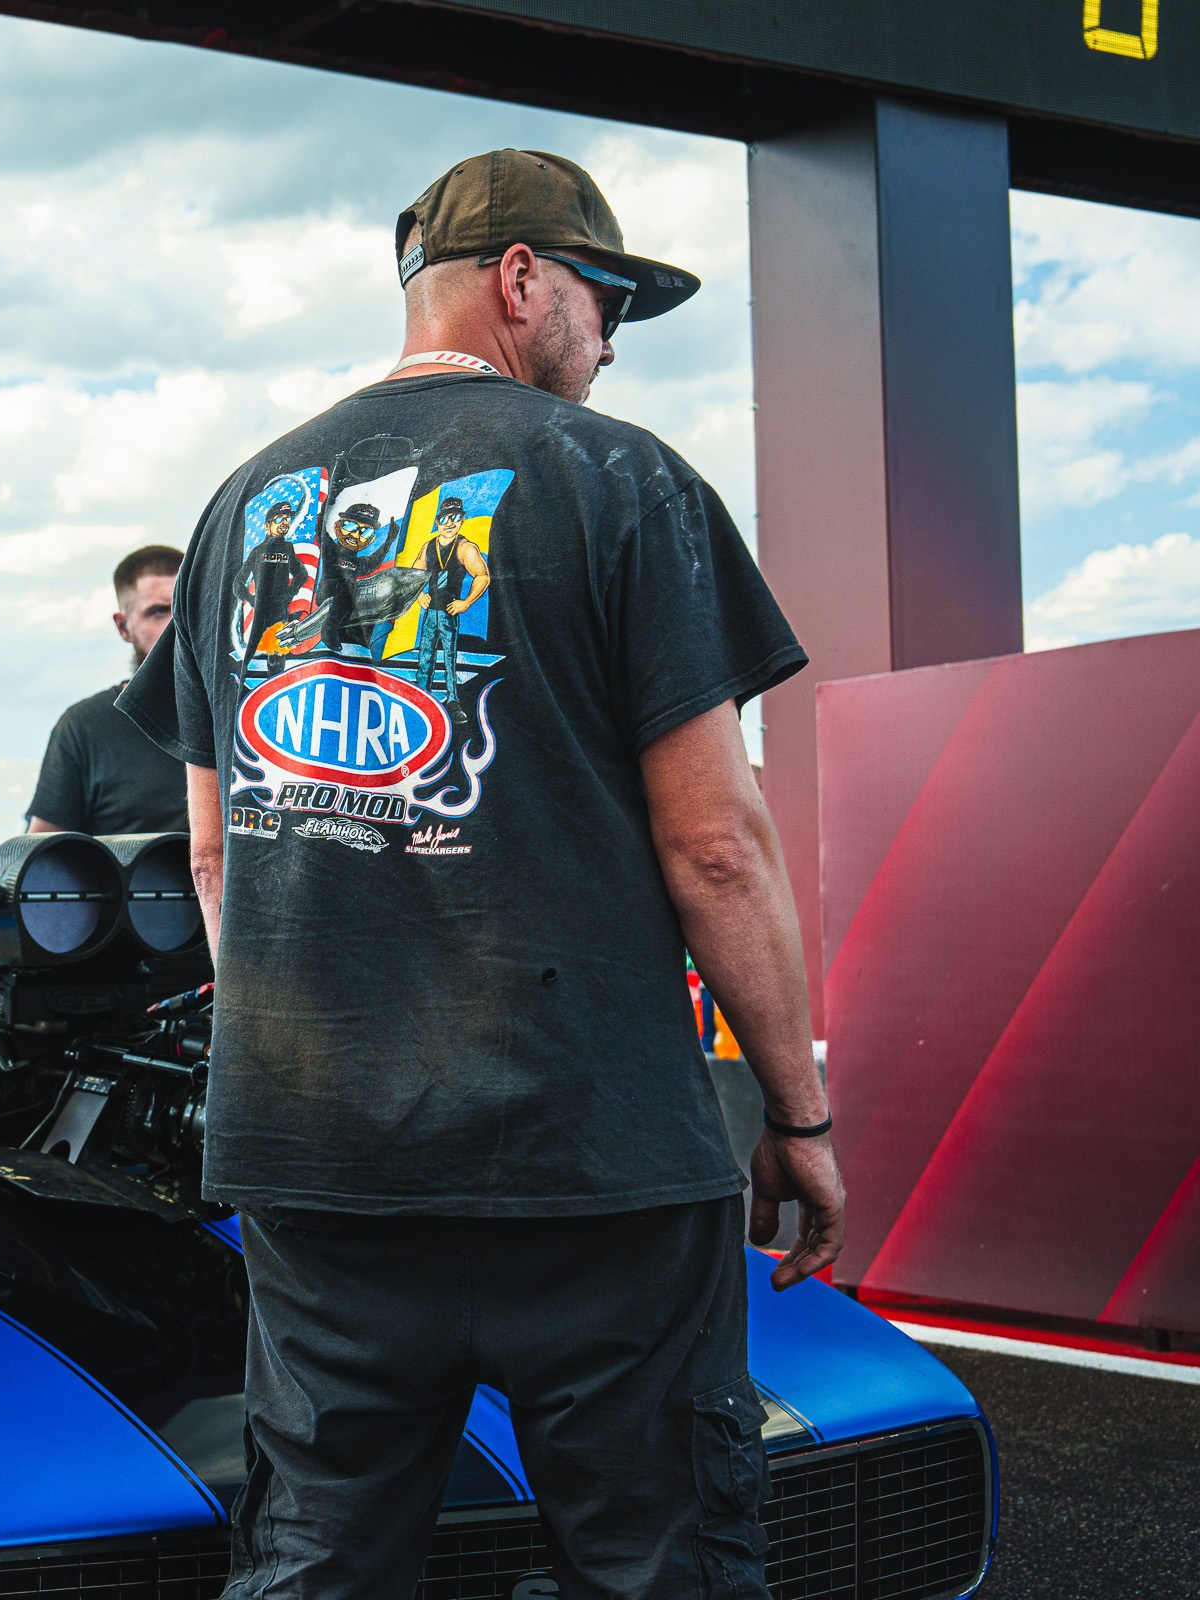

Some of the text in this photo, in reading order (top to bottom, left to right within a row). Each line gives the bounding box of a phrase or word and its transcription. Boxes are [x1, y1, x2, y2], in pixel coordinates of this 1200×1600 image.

[275, 683, 411, 766] NHRA
[275, 782, 406, 822] PRO MOD
[305, 819, 372, 842] FLAMHOLC
[404, 845, 473, 855] SUPERCHARGERS
